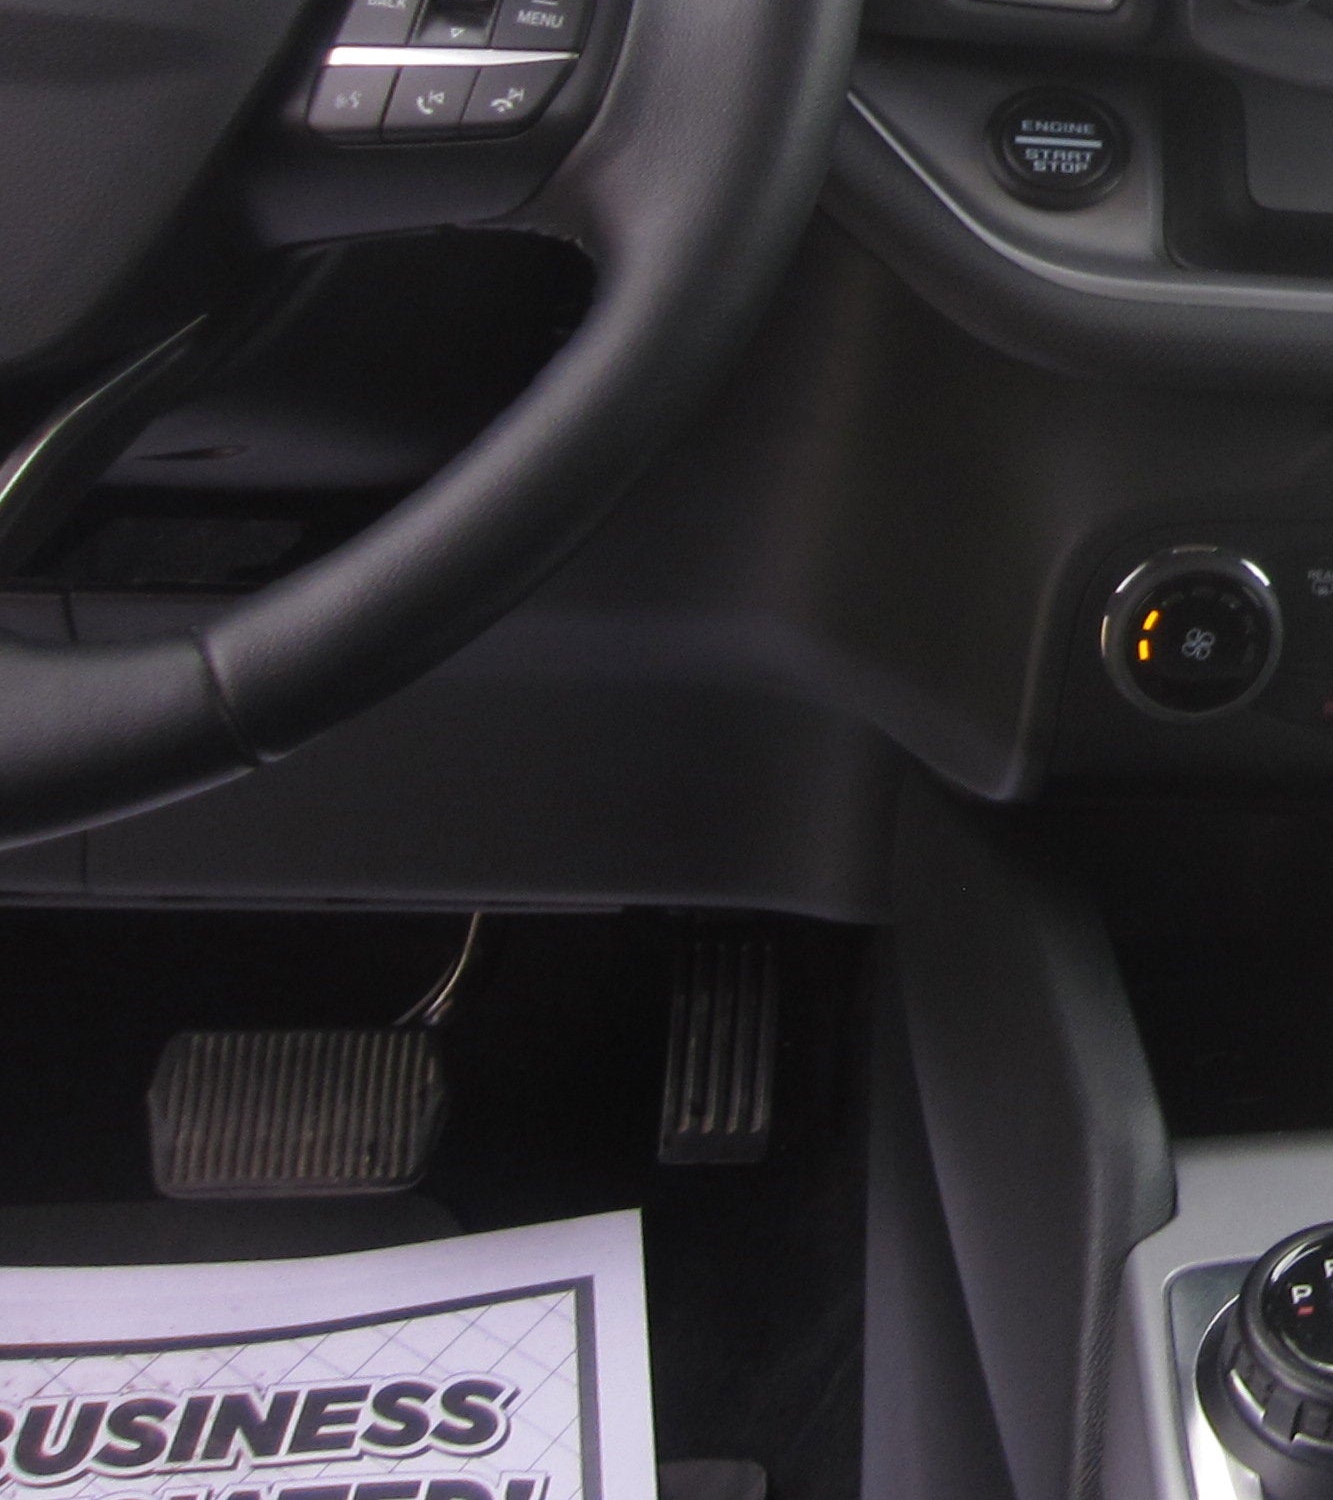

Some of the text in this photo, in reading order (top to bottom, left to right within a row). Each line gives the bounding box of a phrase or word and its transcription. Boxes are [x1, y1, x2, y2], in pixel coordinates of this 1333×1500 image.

[516, 9, 565, 29] MENU
[1020, 118, 1096, 136] ENGINE
[1024, 147, 1094, 163] START
[1032, 160, 1090, 174] STOP
[1290, 1283, 1314, 1305] P
[0, 1378, 516, 1476] USINESS
